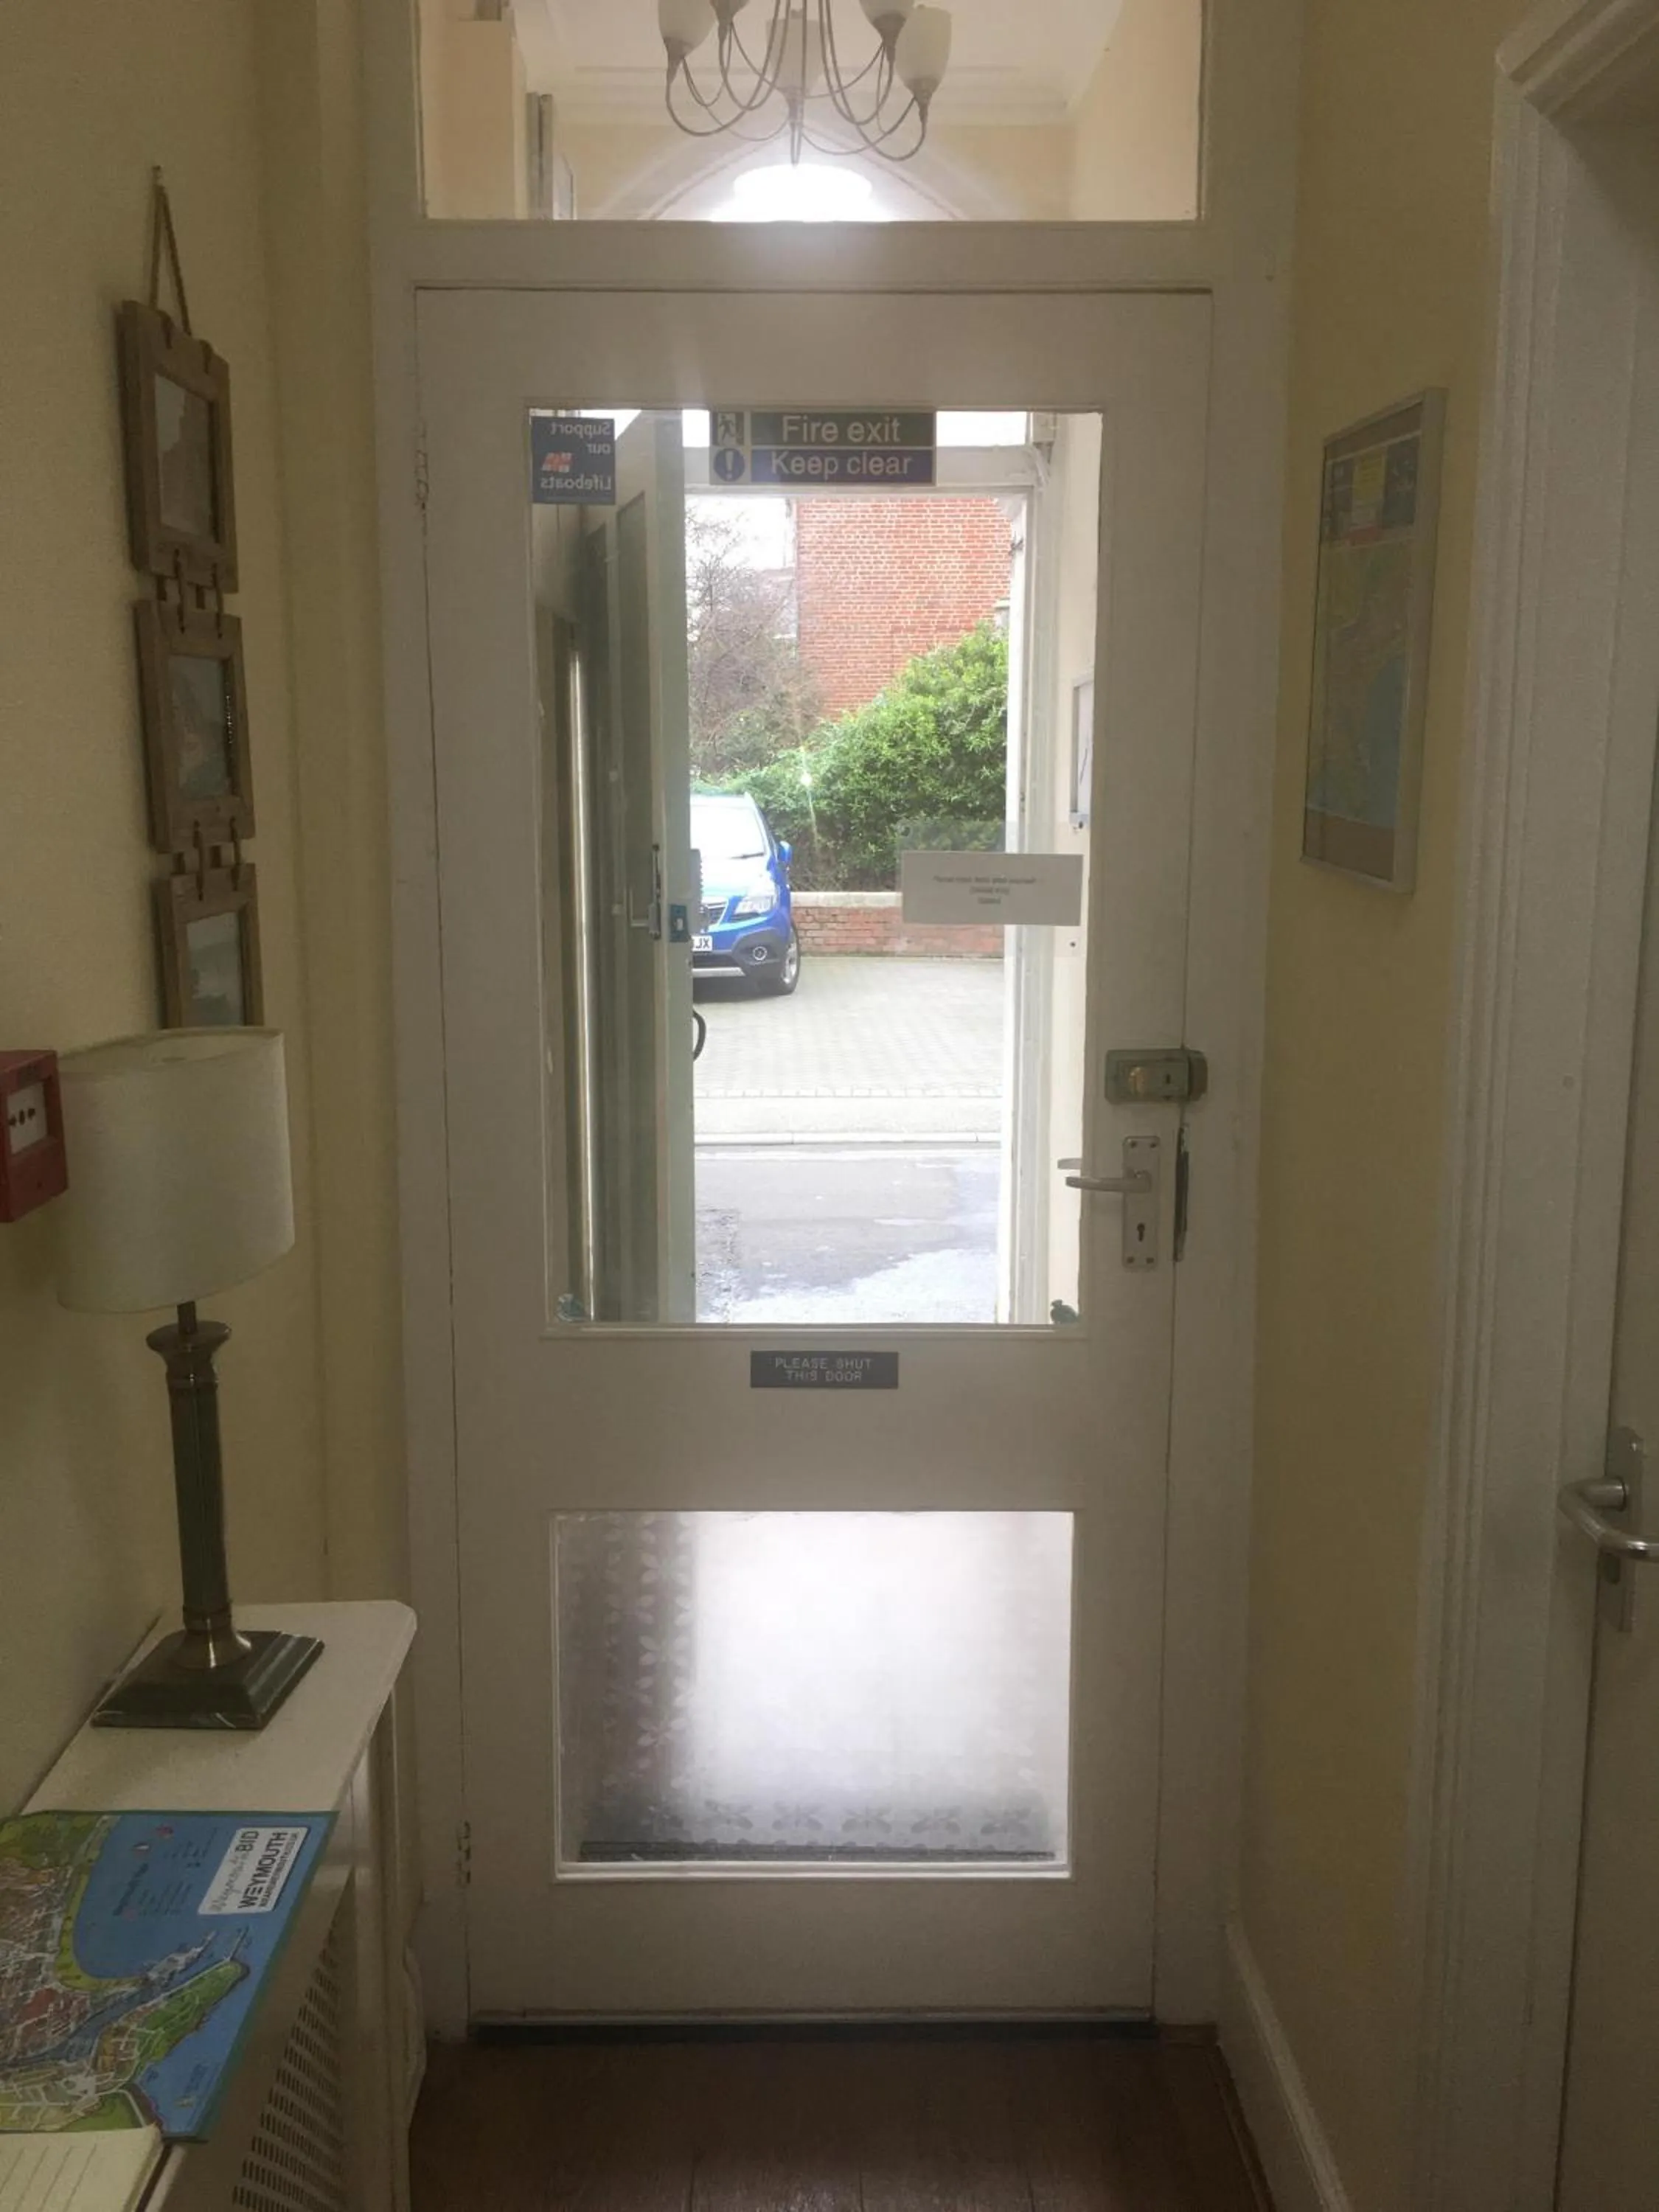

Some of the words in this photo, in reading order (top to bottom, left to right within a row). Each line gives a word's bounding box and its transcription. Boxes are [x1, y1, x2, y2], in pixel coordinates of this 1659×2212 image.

[782, 414, 839, 443] Fire
[846, 416, 901, 443] exit
[771, 451, 839, 481] Keep
[846, 451, 913, 475] clear
[694, 937, 710, 949] JX
[774, 1357, 829, 1369] PLEASE
[835, 1357, 873, 1370] SHUT
[785, 1370, 818, 1382] THIS
[825, 1370, 862, 1382] DOOR
[234, 1830, 260, 1853] BID
[237, 1831, 288, 1909] WEYMOUTH
